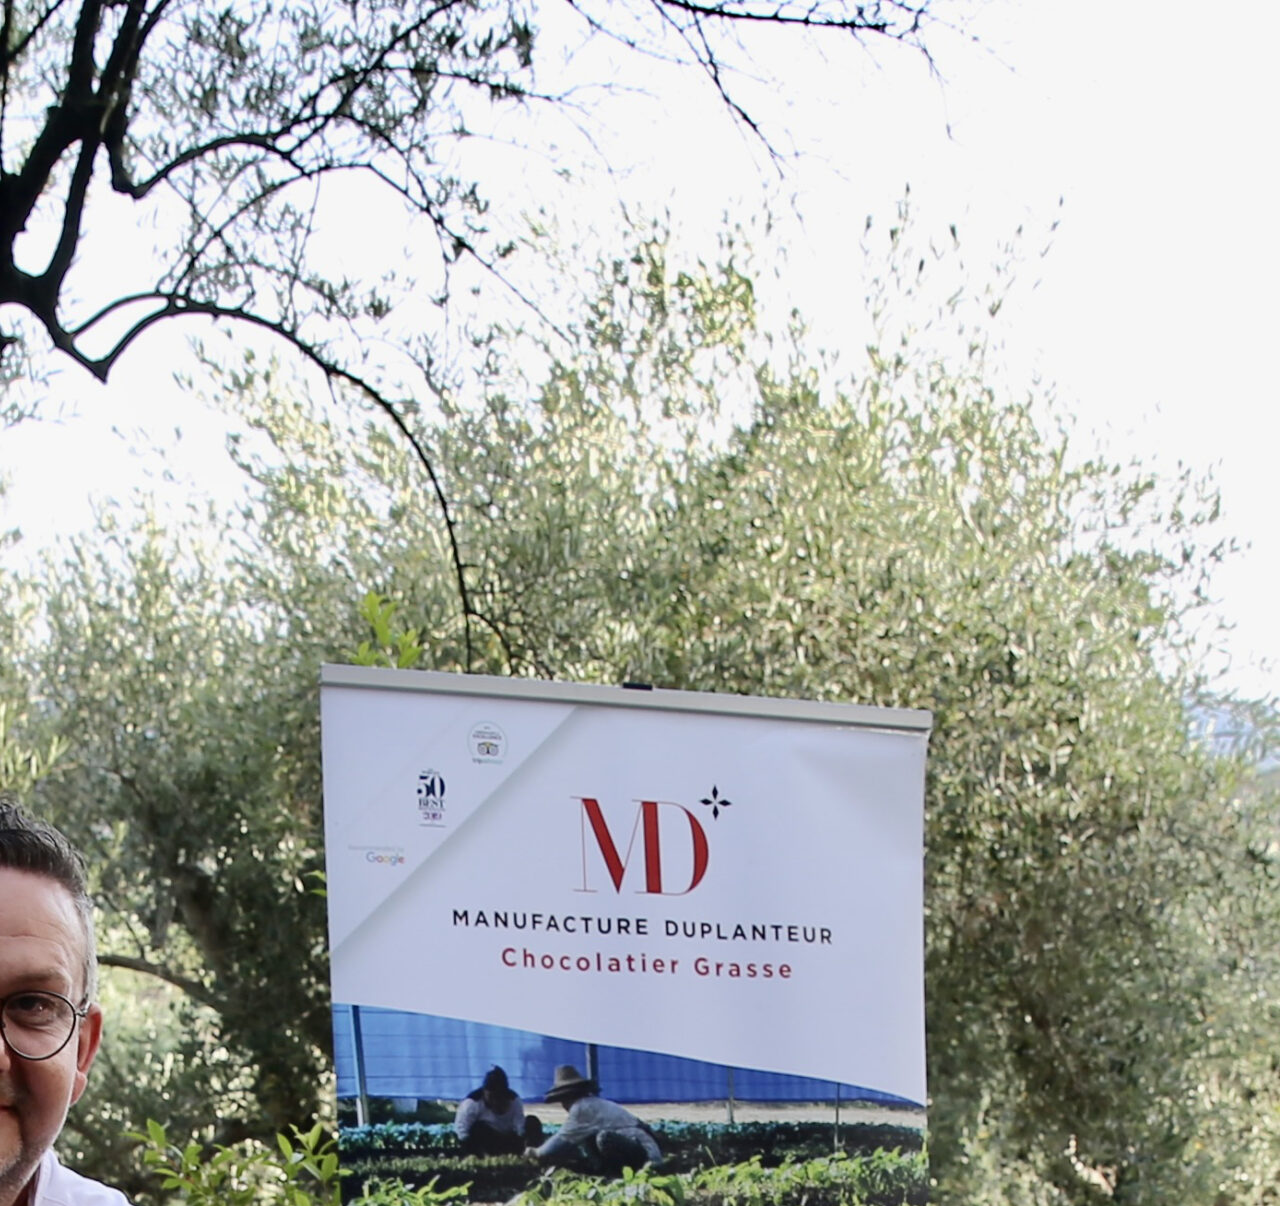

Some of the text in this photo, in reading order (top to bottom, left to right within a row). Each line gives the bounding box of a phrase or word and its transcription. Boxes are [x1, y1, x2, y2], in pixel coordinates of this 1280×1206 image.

[417, 774, 446, 798] 50
[365, 851, 406, 867] Google
[570, 796, 709, 896] MD
[452, 909, 833, 945] MANUFACTURE DUPLANTEUR
[501, 947, 793, 979] Chocolatier Grasse
